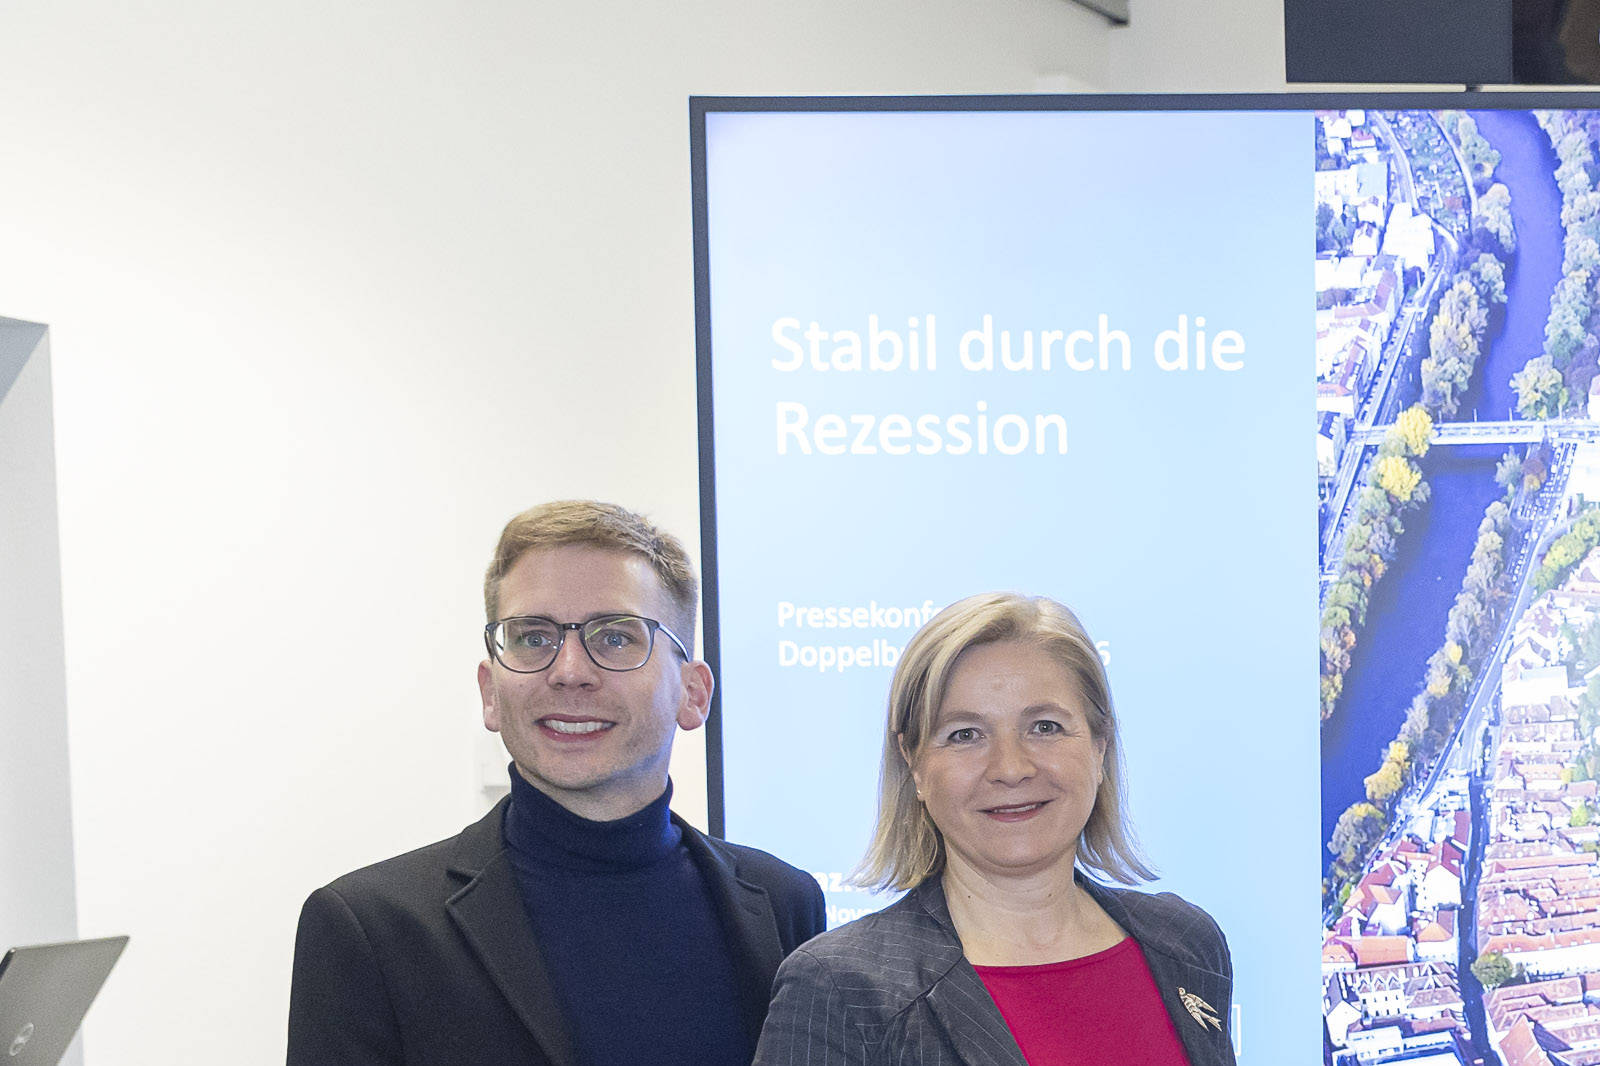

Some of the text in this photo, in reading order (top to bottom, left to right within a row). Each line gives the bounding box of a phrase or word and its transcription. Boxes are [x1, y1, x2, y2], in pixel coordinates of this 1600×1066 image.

[770, 313, 1246, 372] Stabil durch die
[776, 401, 1069, 456] Rezession
[779, 637, 905, 674] Doppelb
